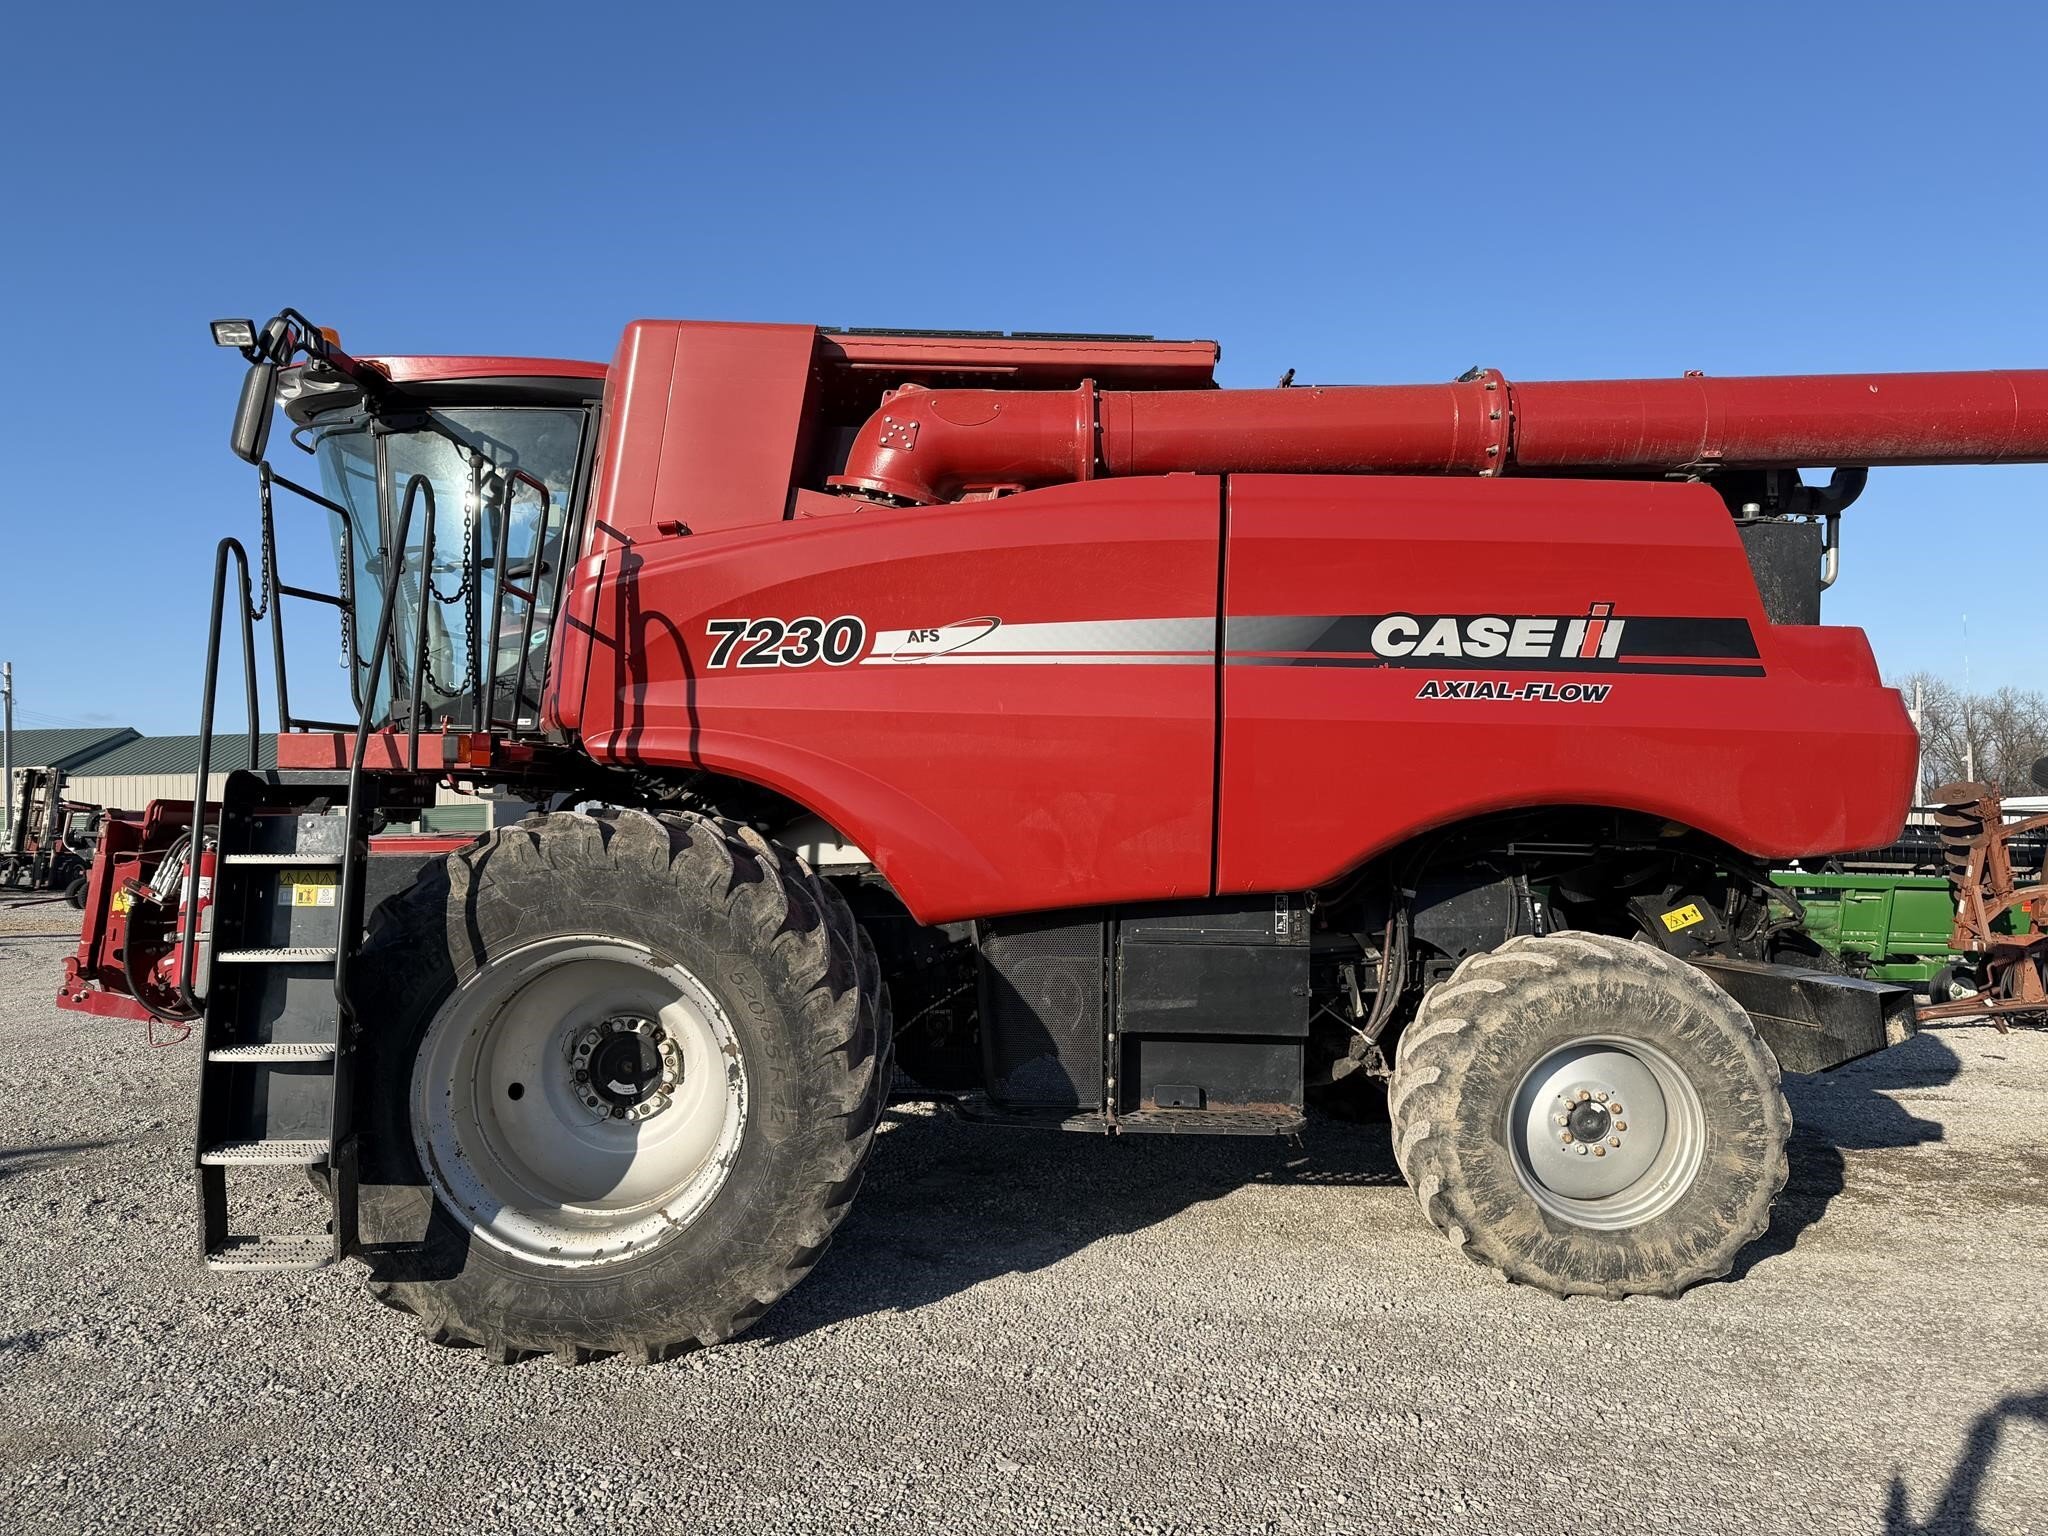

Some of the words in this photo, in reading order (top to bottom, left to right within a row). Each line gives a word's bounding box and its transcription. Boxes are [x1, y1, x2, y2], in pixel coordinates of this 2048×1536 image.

[705, 615, 867, 669] 7230
[906, 628, 941, 644] AFS
[1370, 616, 1557, 660] CASE
[1416, 680, 1613, 704] AXIAL-FLOW
